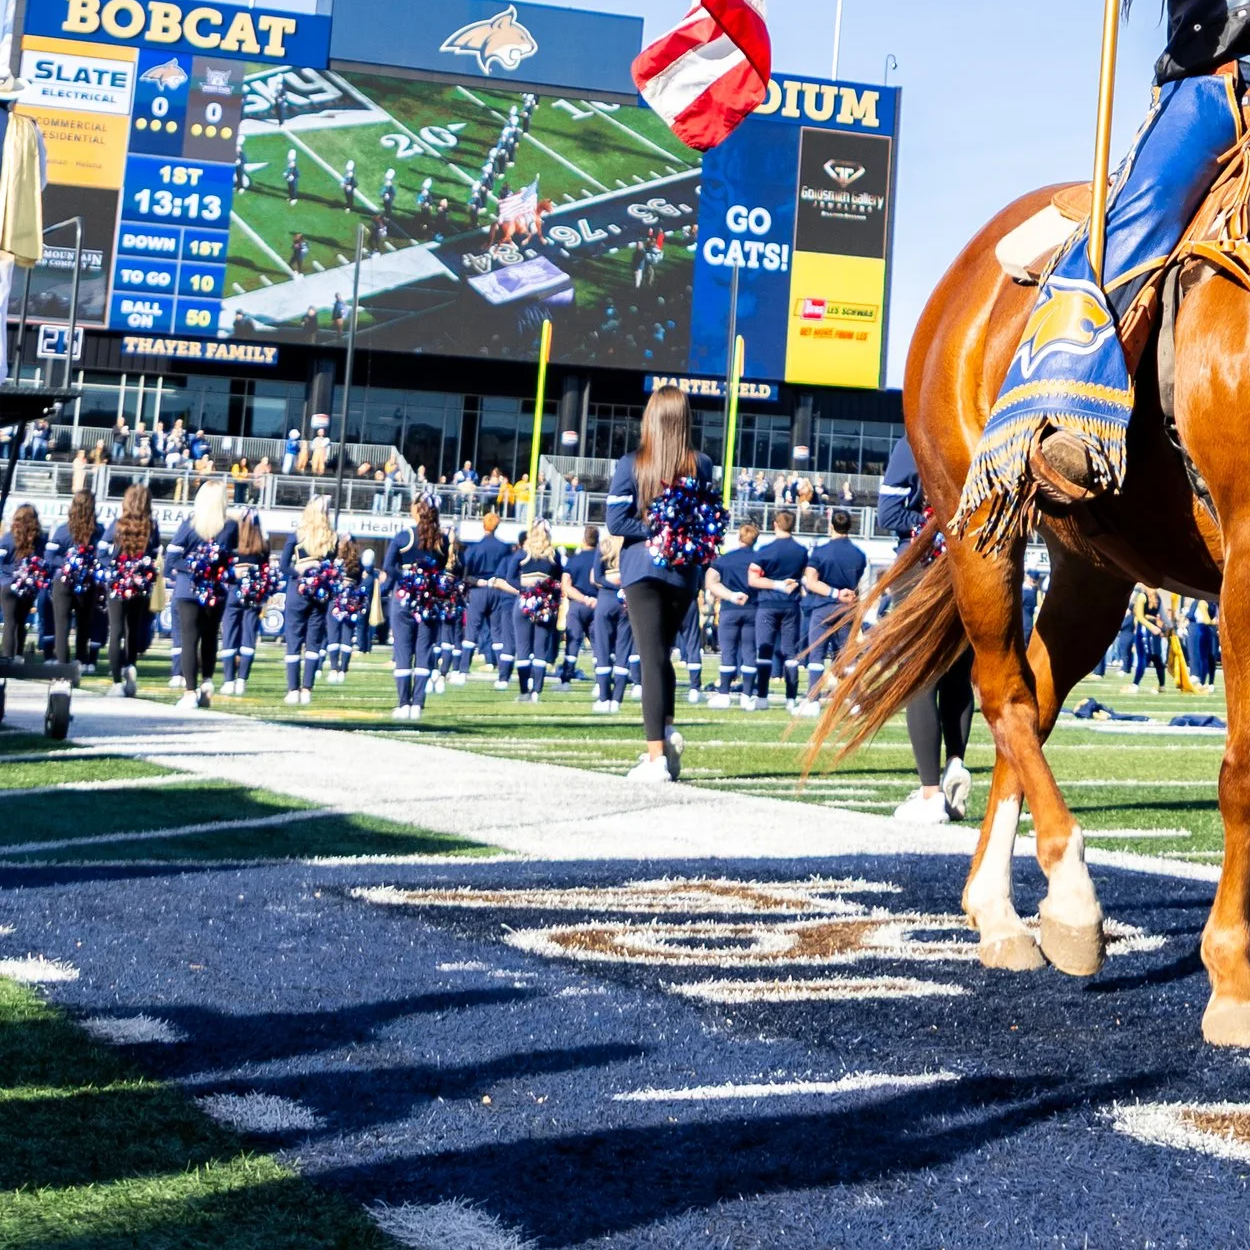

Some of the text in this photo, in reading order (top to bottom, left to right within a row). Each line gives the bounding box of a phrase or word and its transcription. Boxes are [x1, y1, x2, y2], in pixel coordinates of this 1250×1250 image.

[34, 58, 128, 88] SLATE
[41, 87, 117, 104] ELECTRICAL
[751, 78, 880, 128] DIUM
[151, 96, 169, 117] 0
[205, 102, 223, 123] 0
[36, 116, 108, 132] COMMERCIAL
[42, 130, 105, 145] ESIDENTIAL
[159, 165, 203, 186] 1ST
[134, 188, 222, 220] 13:13
[726, 205, 772, 235] GO
[122, 234, 176, 252] DOWN
[189, 240, 223, 257] 1ST
[44, 249, 103, 265] MOUNAIN
[702, 237, 790, 271] CATS!
[120, 269, 171, 287] TO GO
[189, 274, 215, 293] 10
[121, 299, 163, 316] BALL
[127, 313, 153, 328] ON
[185, 309, 211, 327] 50
[124, 336, 277, 364] THAYER FAMILY
